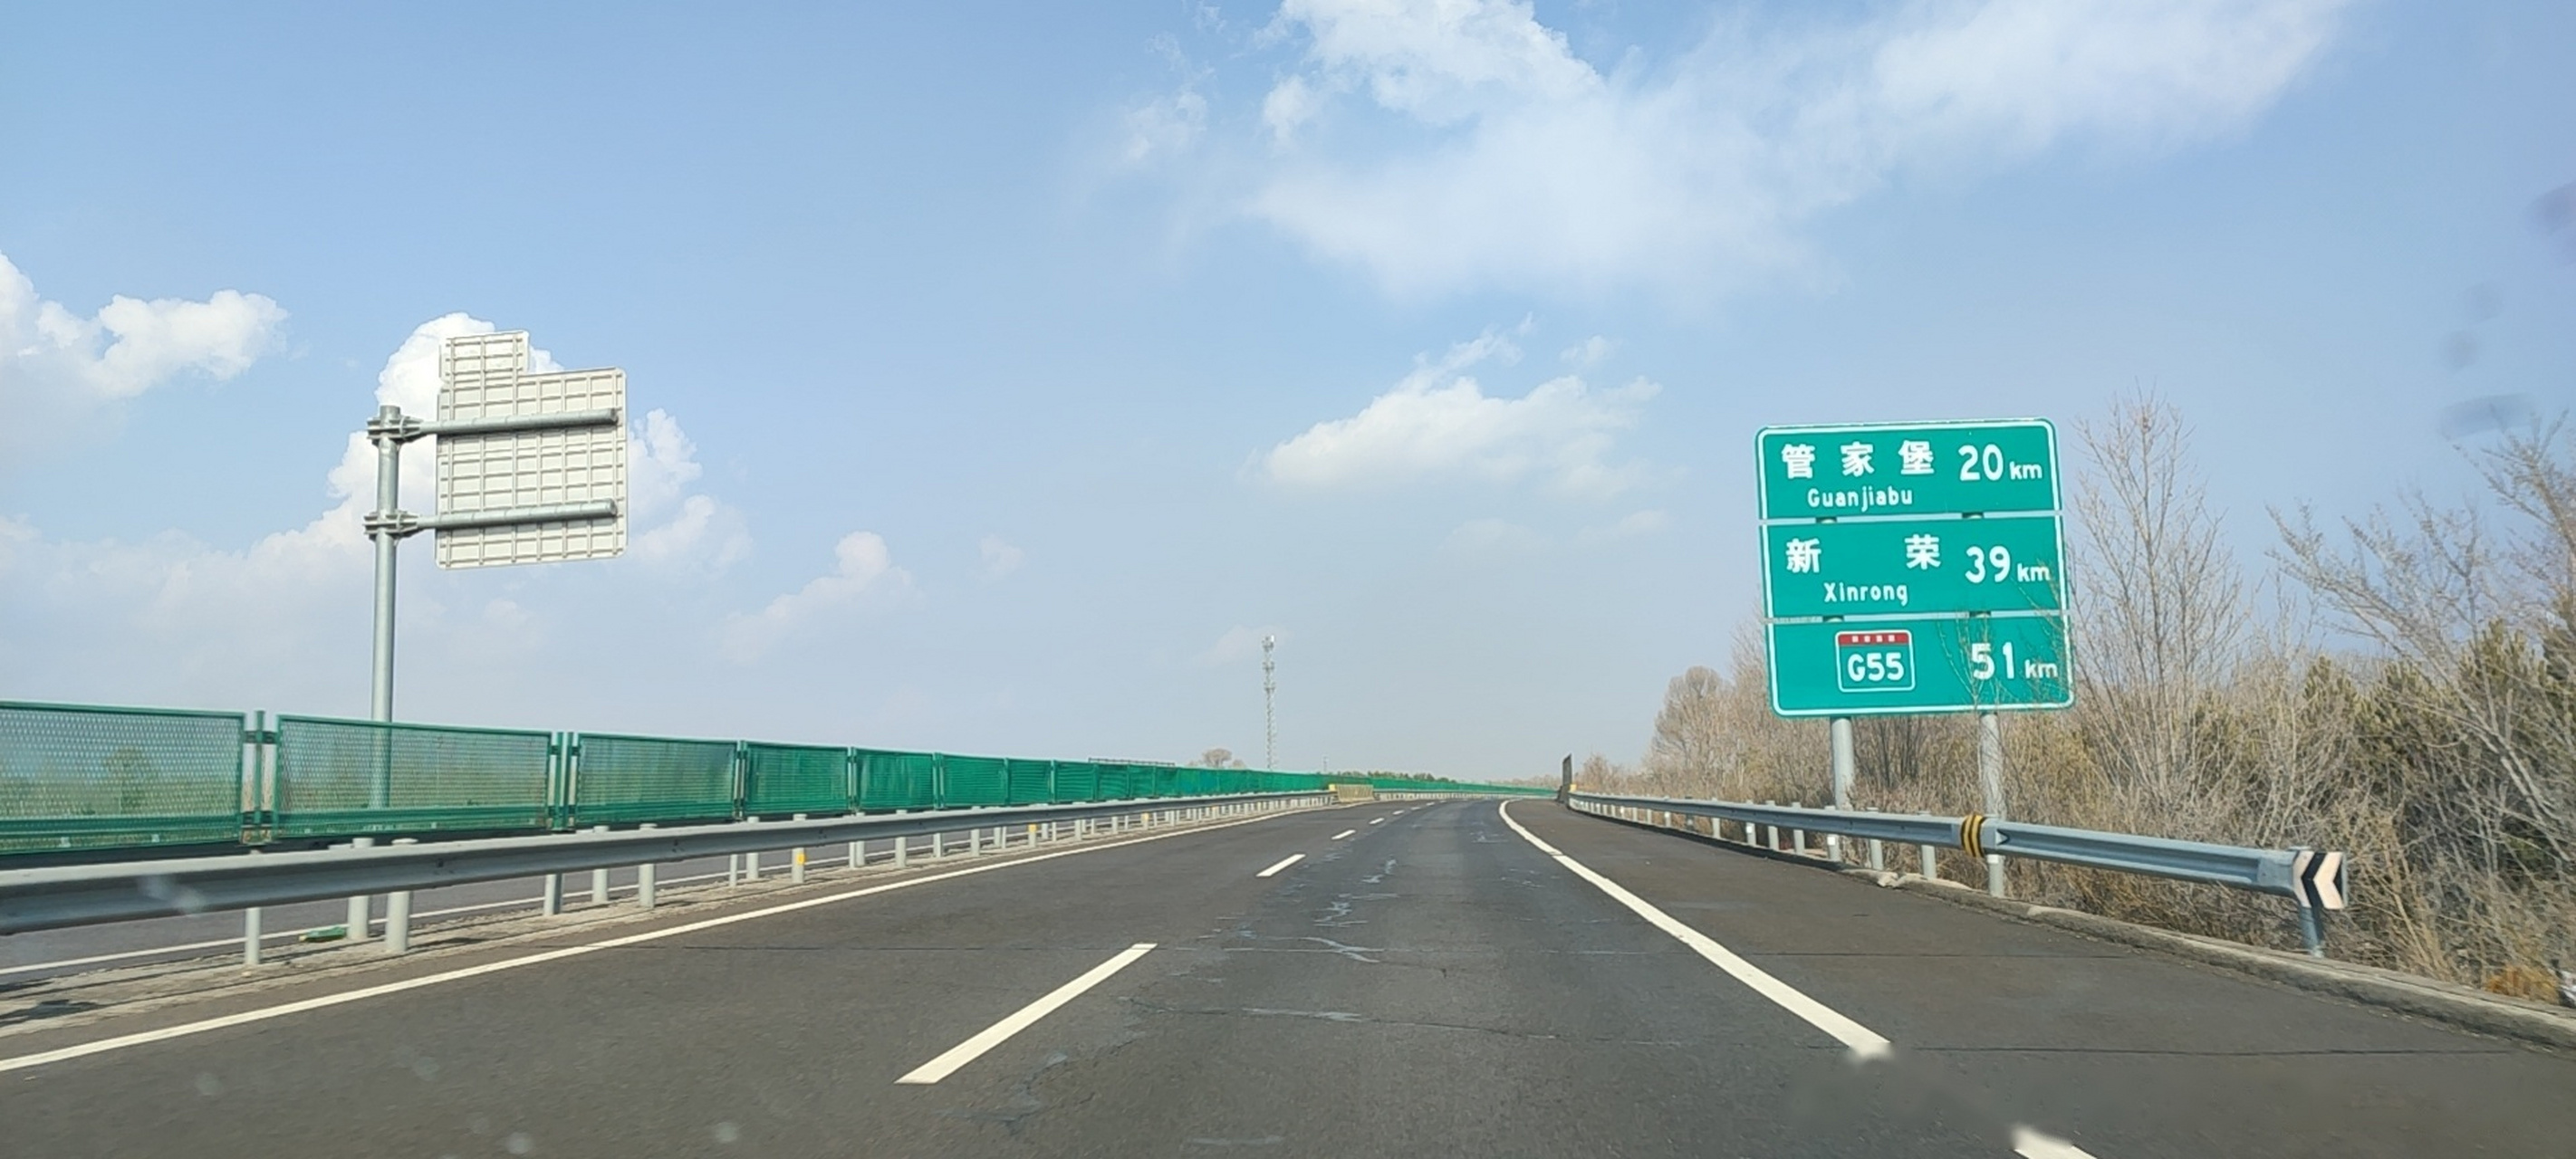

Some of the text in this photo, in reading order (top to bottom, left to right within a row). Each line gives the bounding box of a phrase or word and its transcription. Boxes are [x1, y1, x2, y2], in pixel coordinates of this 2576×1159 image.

[1781, 439, 2043, 482] 管家堡 20 km
[1807, 485, 1913, 512] Guanjiabu
[1785, 533, 2051, 584] 新荣 39 km
[1823, 581, 1908, 606] Xinrong
[1847, 652, 1905, 682] G55
[1971, 641, 2059, 681] 51 km
